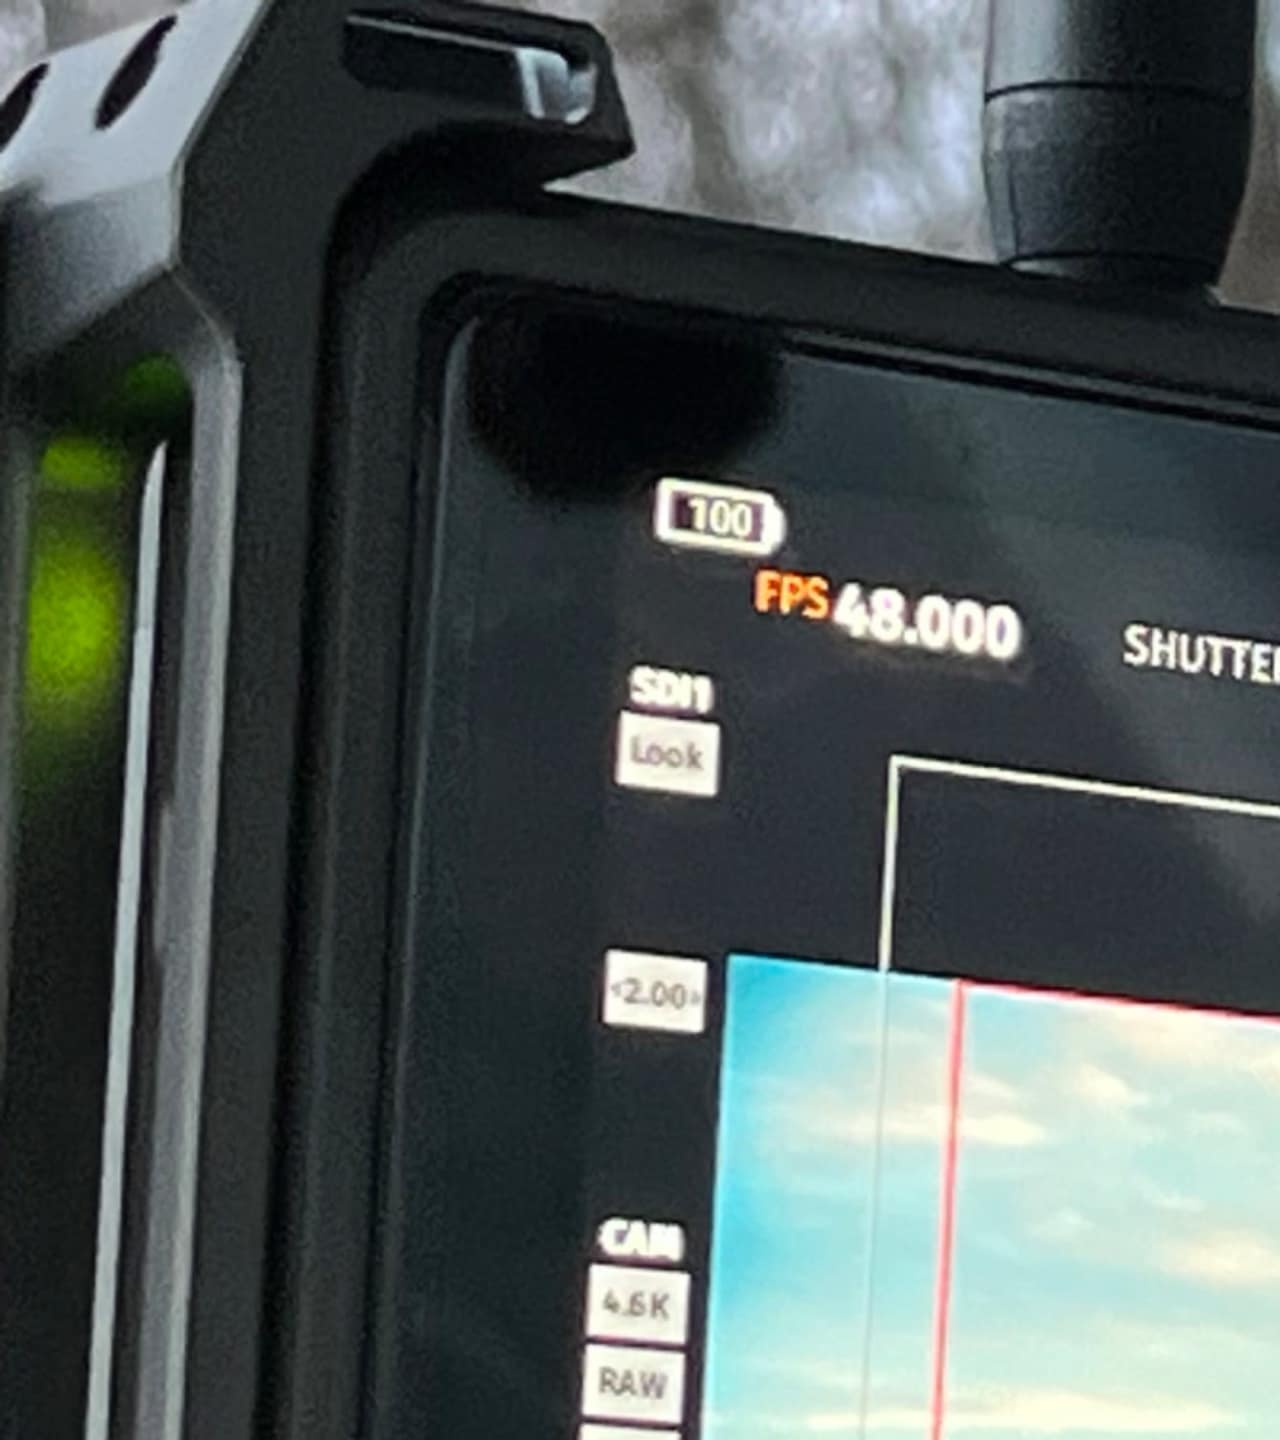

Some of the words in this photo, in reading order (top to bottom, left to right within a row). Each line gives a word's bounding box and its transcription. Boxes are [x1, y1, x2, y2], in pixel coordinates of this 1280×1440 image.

[687, 497, 752, 538] 100
[755, 569, 831, 620] FPS
[832, 582, 1022, 659] 48.000
[629, 664, 713, 714] SDI1
[630, 736, 703, 771] Look
[598, 1217, 685, 1262] CAM
[602, 1290, 671, 1321] 4.6K
[599, 1366, 668, 1400] RAW
